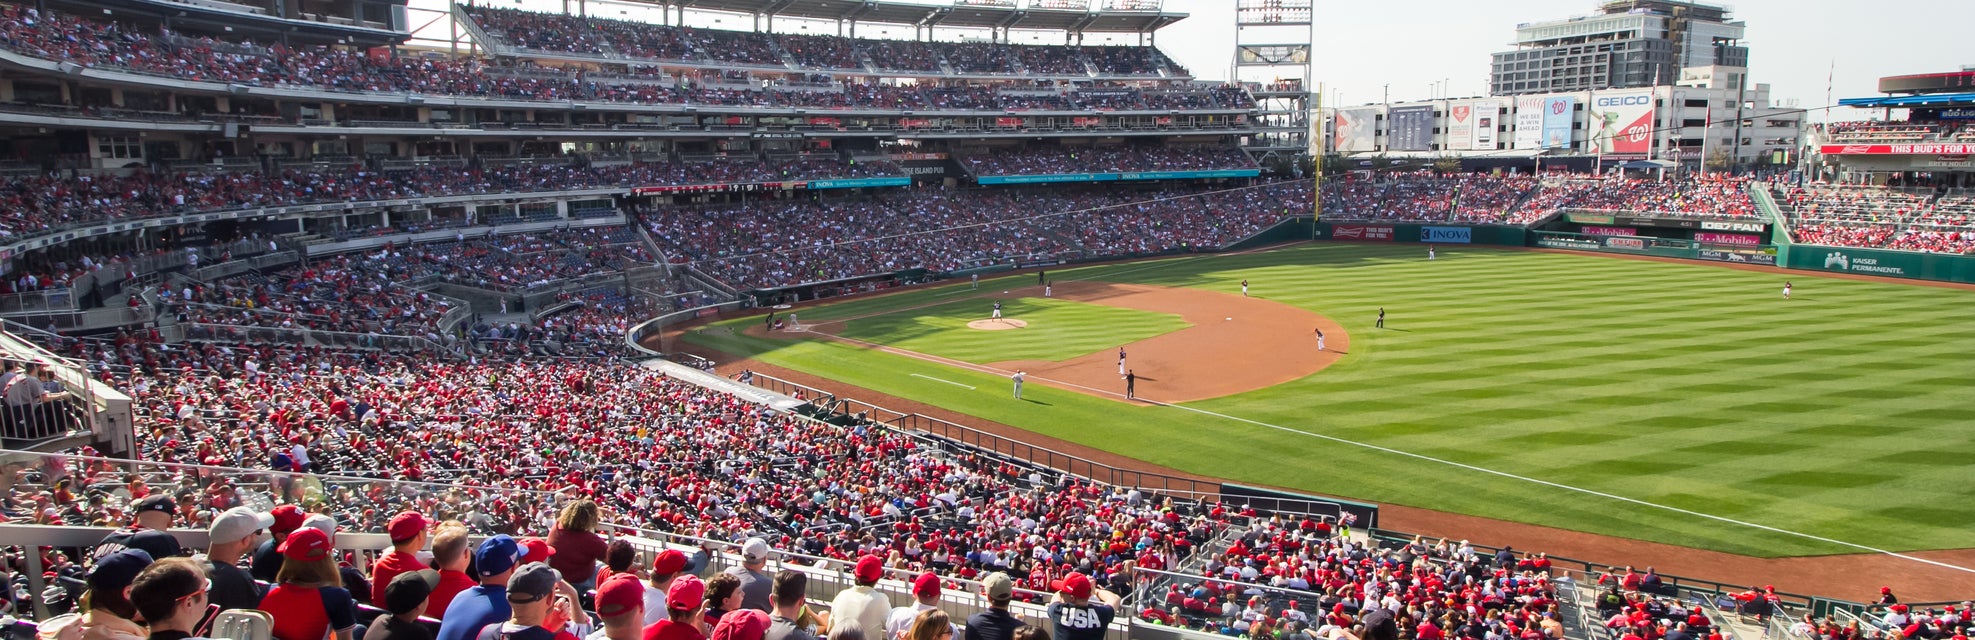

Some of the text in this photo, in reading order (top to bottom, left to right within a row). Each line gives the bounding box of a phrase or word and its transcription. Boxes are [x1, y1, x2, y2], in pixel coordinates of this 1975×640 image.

[1598, 96, 1648, 106] GEICO
[1628, 124, 1648, 142] W
[1733, 223, 1764, 232] FAN
[1033, 579, 1044, 588] 34
[1060, 606, 1101, 629] USA
